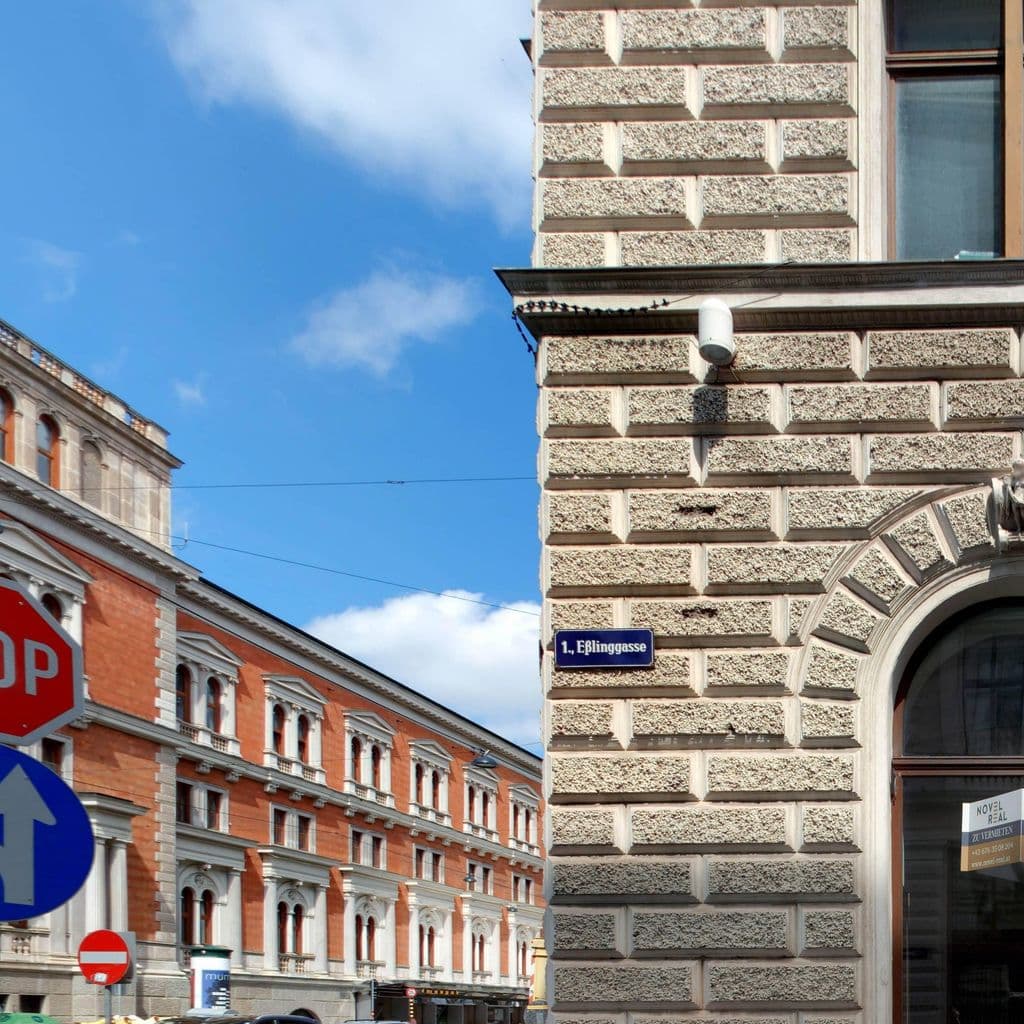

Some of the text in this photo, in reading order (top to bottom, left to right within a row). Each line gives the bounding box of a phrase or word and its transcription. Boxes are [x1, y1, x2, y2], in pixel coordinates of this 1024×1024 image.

[576, 639, 647, 656] Eßlinggasse
[976, 801, 1003, 816] NOVEL
[988, 811, 1008, 825] REAL
